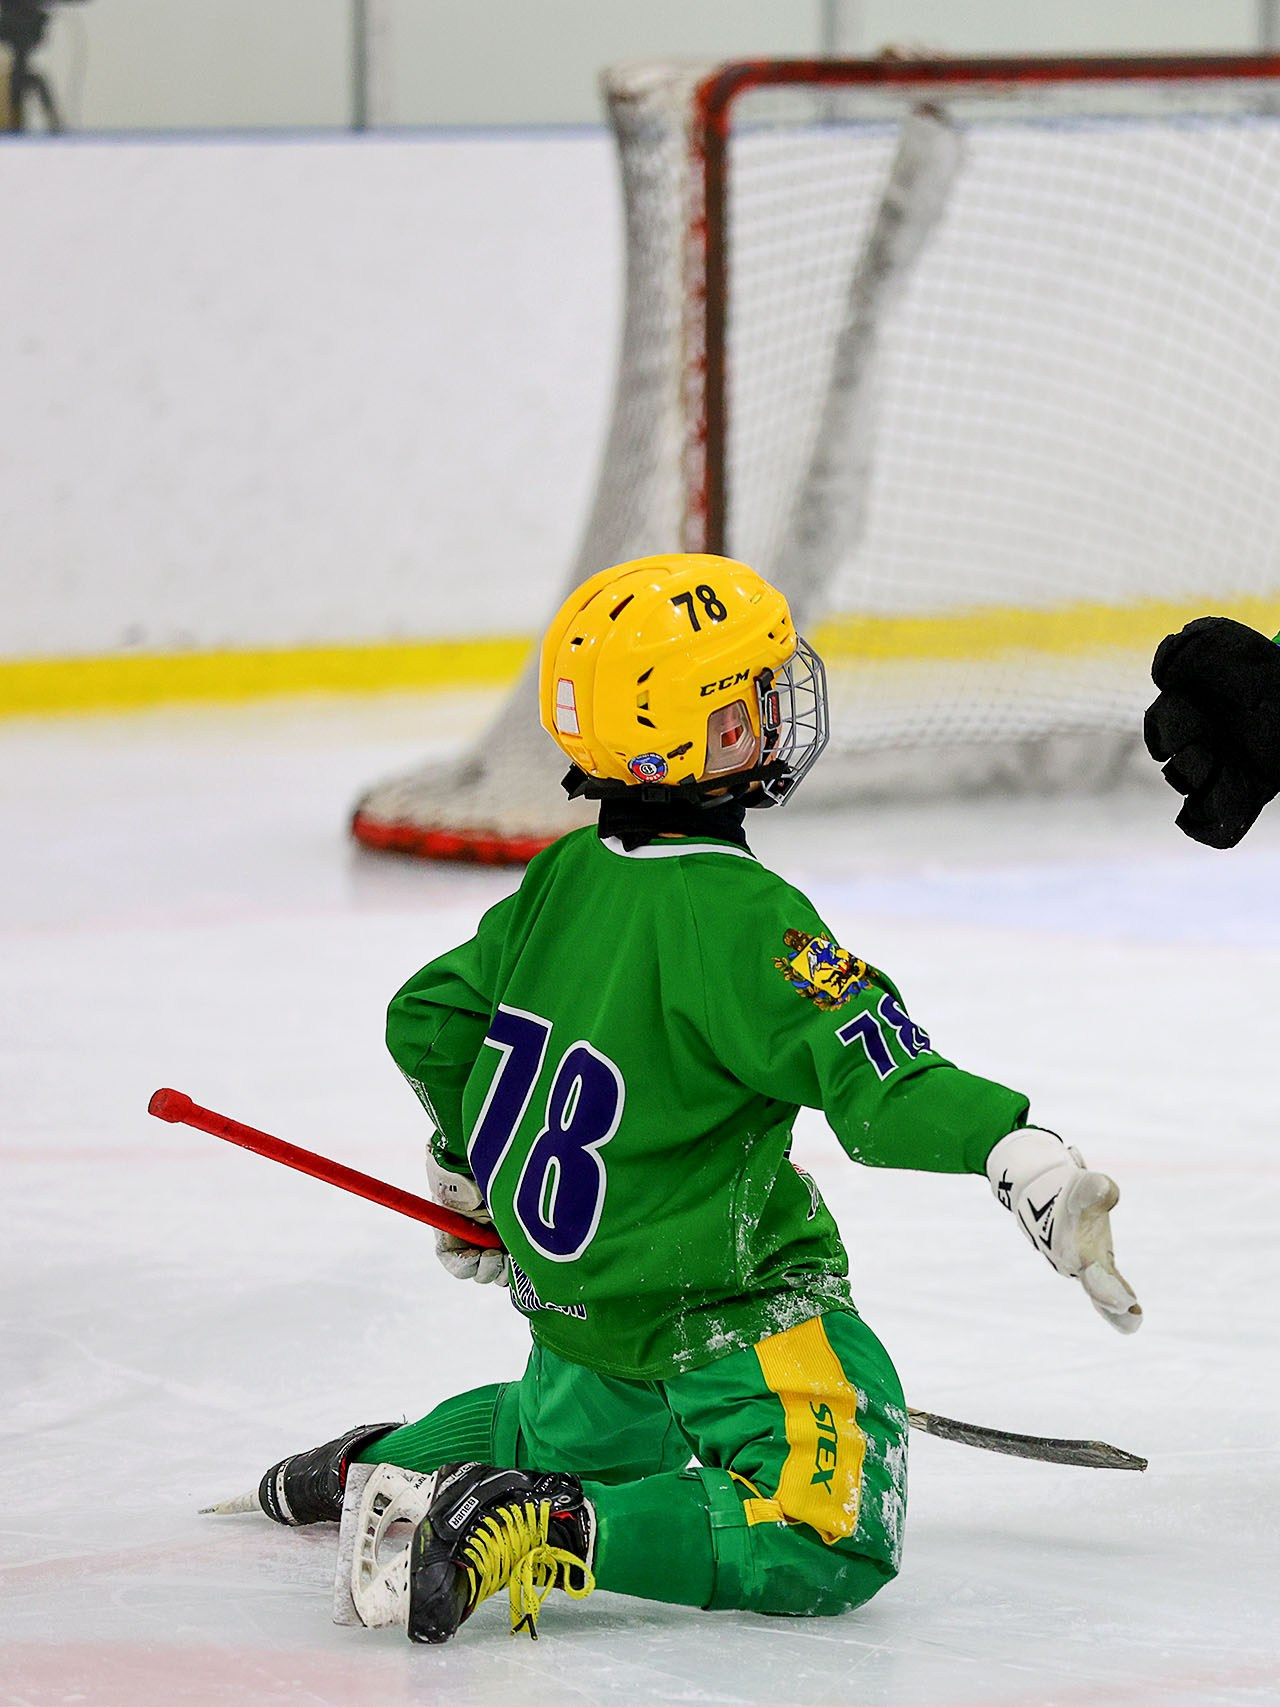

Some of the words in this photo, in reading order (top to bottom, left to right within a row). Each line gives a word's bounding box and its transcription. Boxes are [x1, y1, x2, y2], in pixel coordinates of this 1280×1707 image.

[670, 584, 728, 633] 78
[699, 668, 751, 698] CCM
[834, 992, 933, 1082] 78
[467, 1002, 626, 1263] 78
[809, 1400, 838, 1496] STEX
